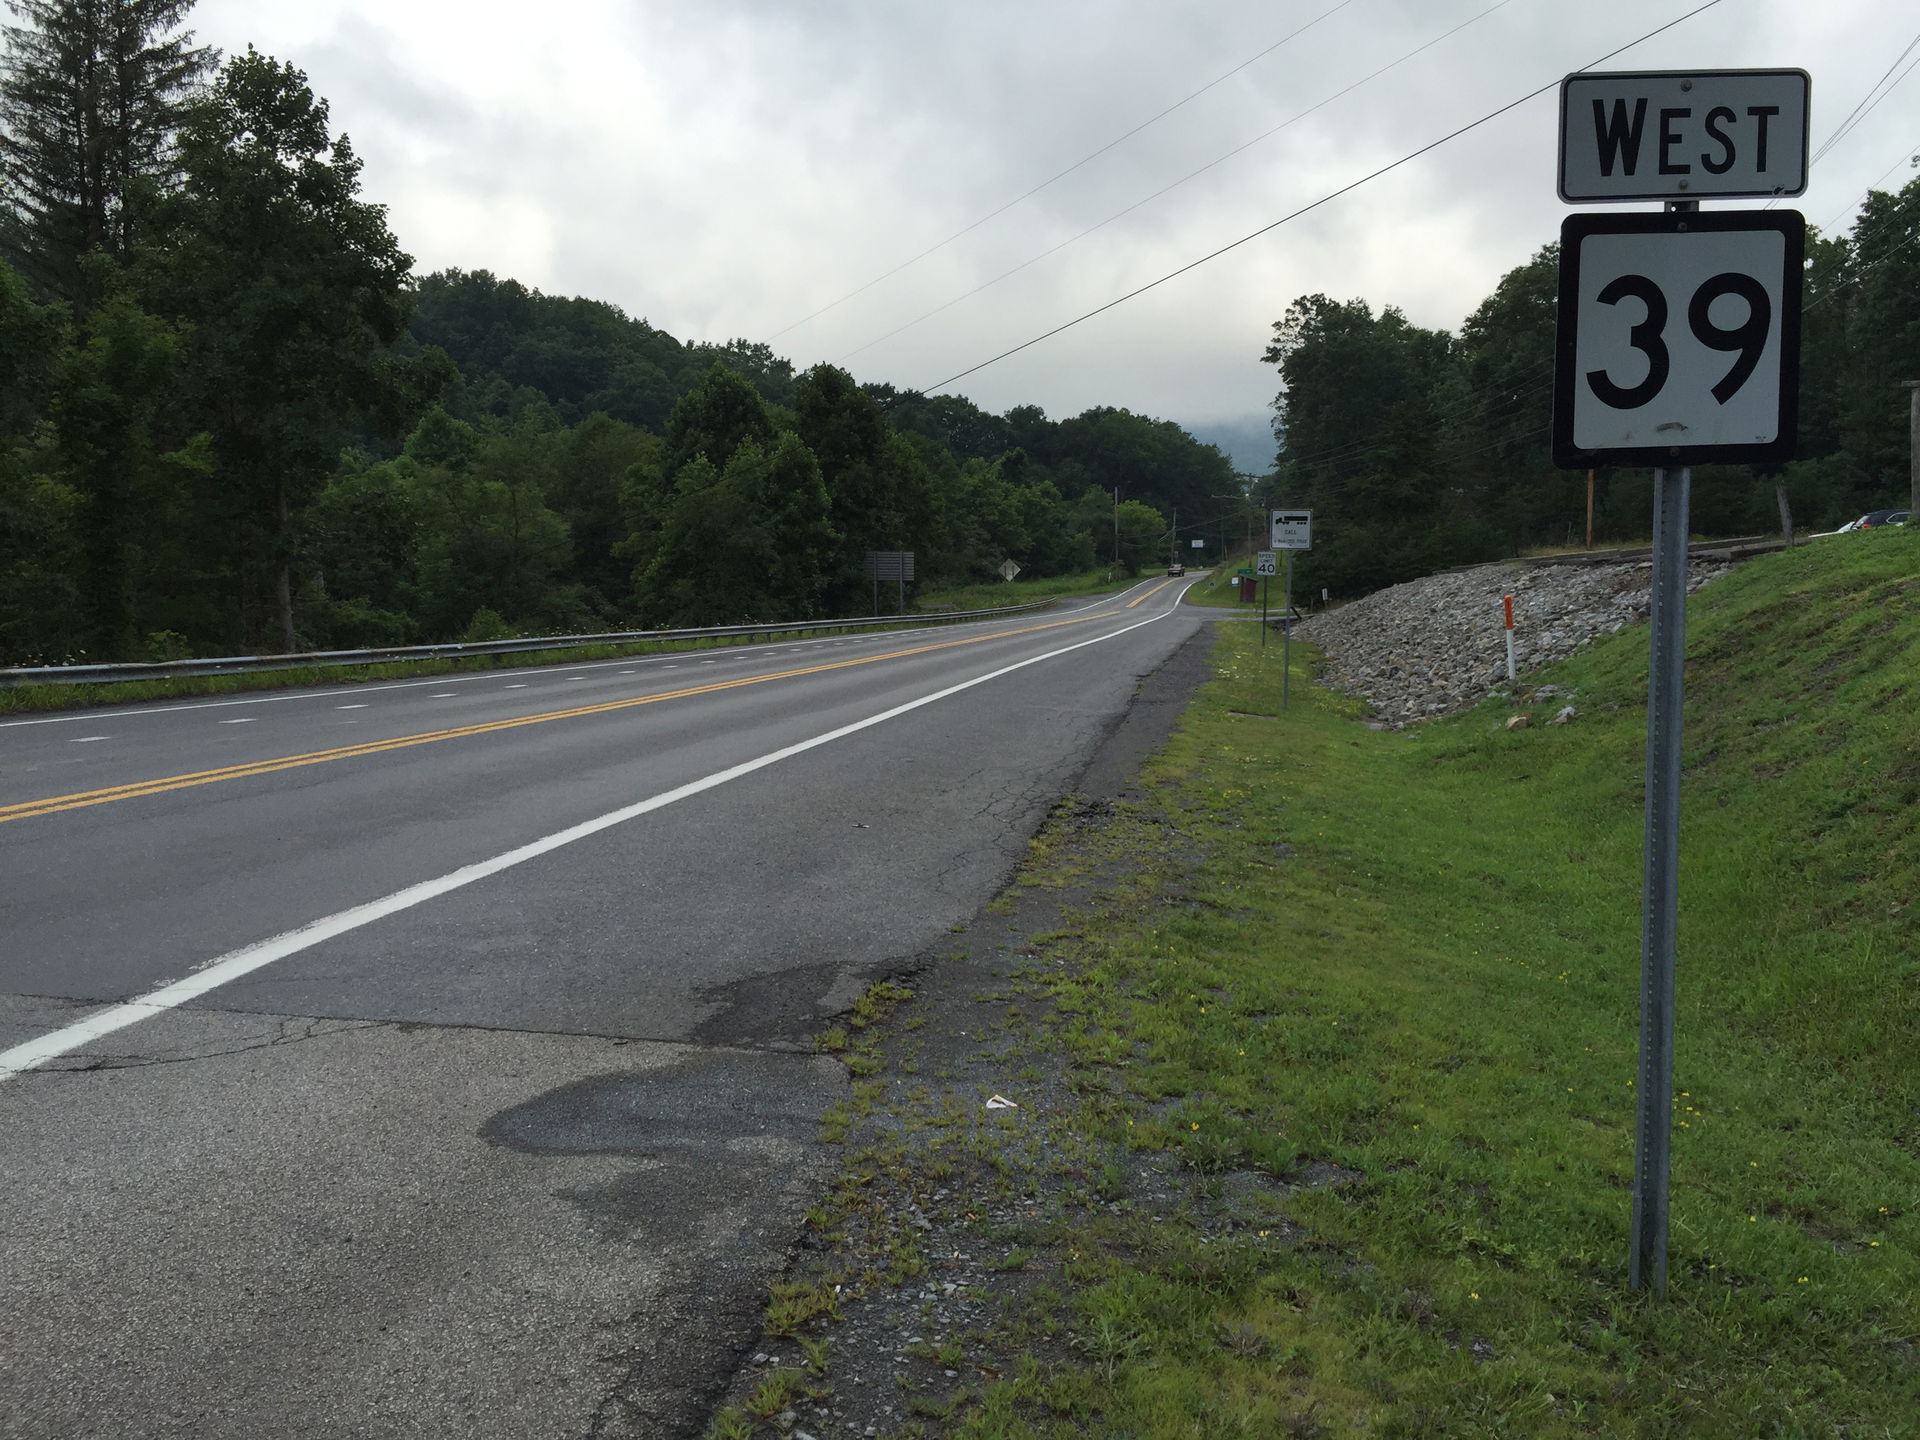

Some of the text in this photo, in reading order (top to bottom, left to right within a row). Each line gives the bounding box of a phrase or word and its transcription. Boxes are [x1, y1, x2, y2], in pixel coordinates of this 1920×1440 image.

[1592, 98, 1779, 177] WEST
[1586, 272, 1771, 410] 39
[1258, 564, 1275, 573] 40
